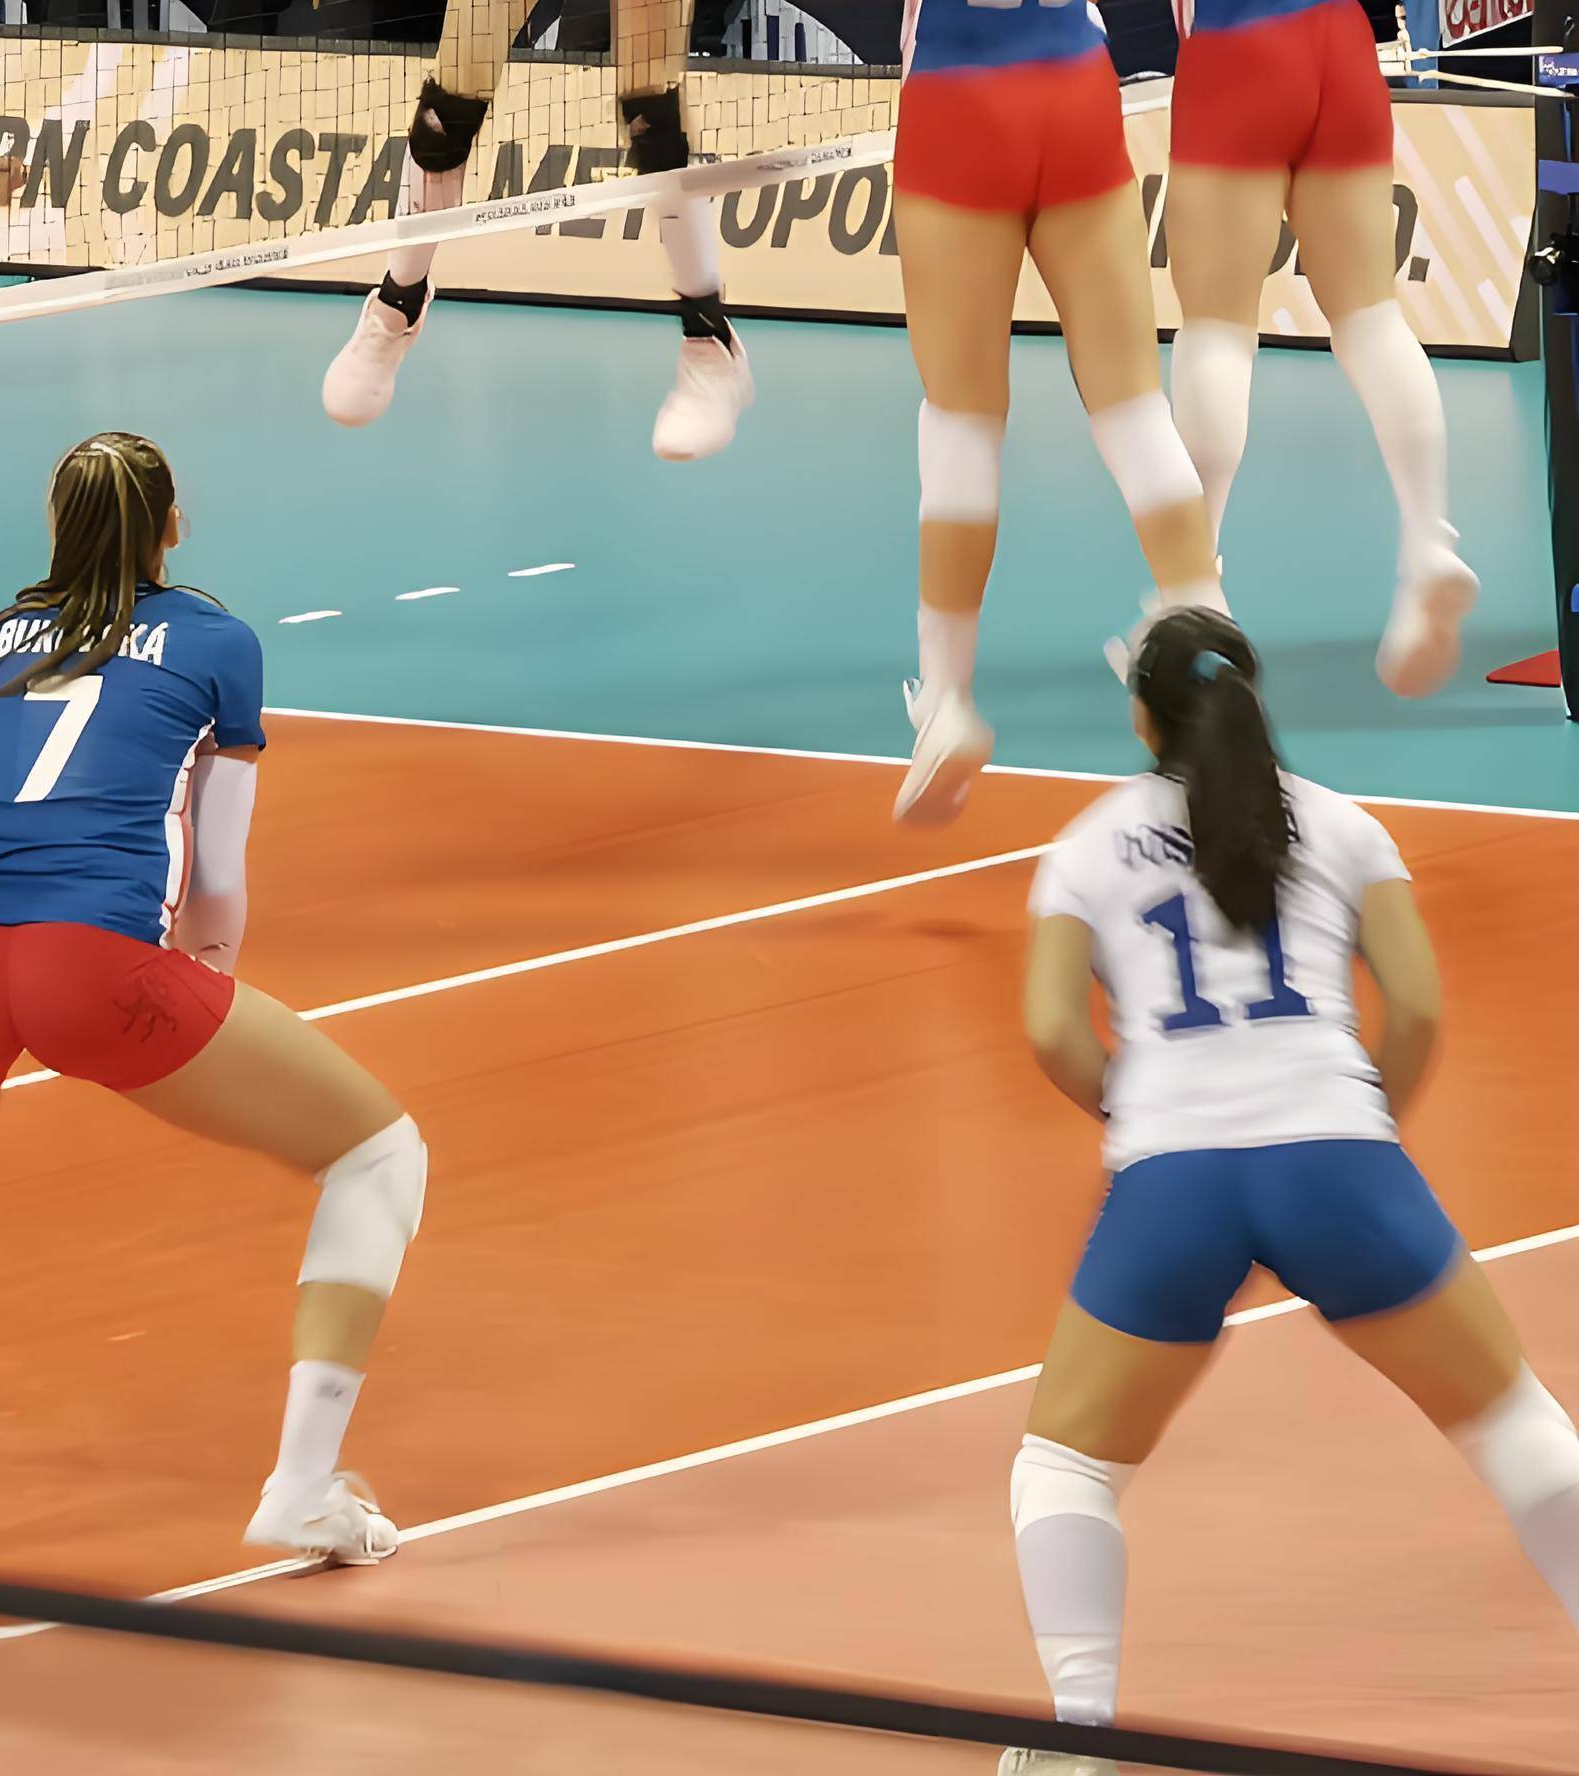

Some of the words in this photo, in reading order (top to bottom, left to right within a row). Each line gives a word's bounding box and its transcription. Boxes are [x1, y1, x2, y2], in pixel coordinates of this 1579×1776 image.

[103, 119, 411, 226] COASTA
[13, 673, 105, 803] 7
[1142, 893, 1313, 1032] 11
